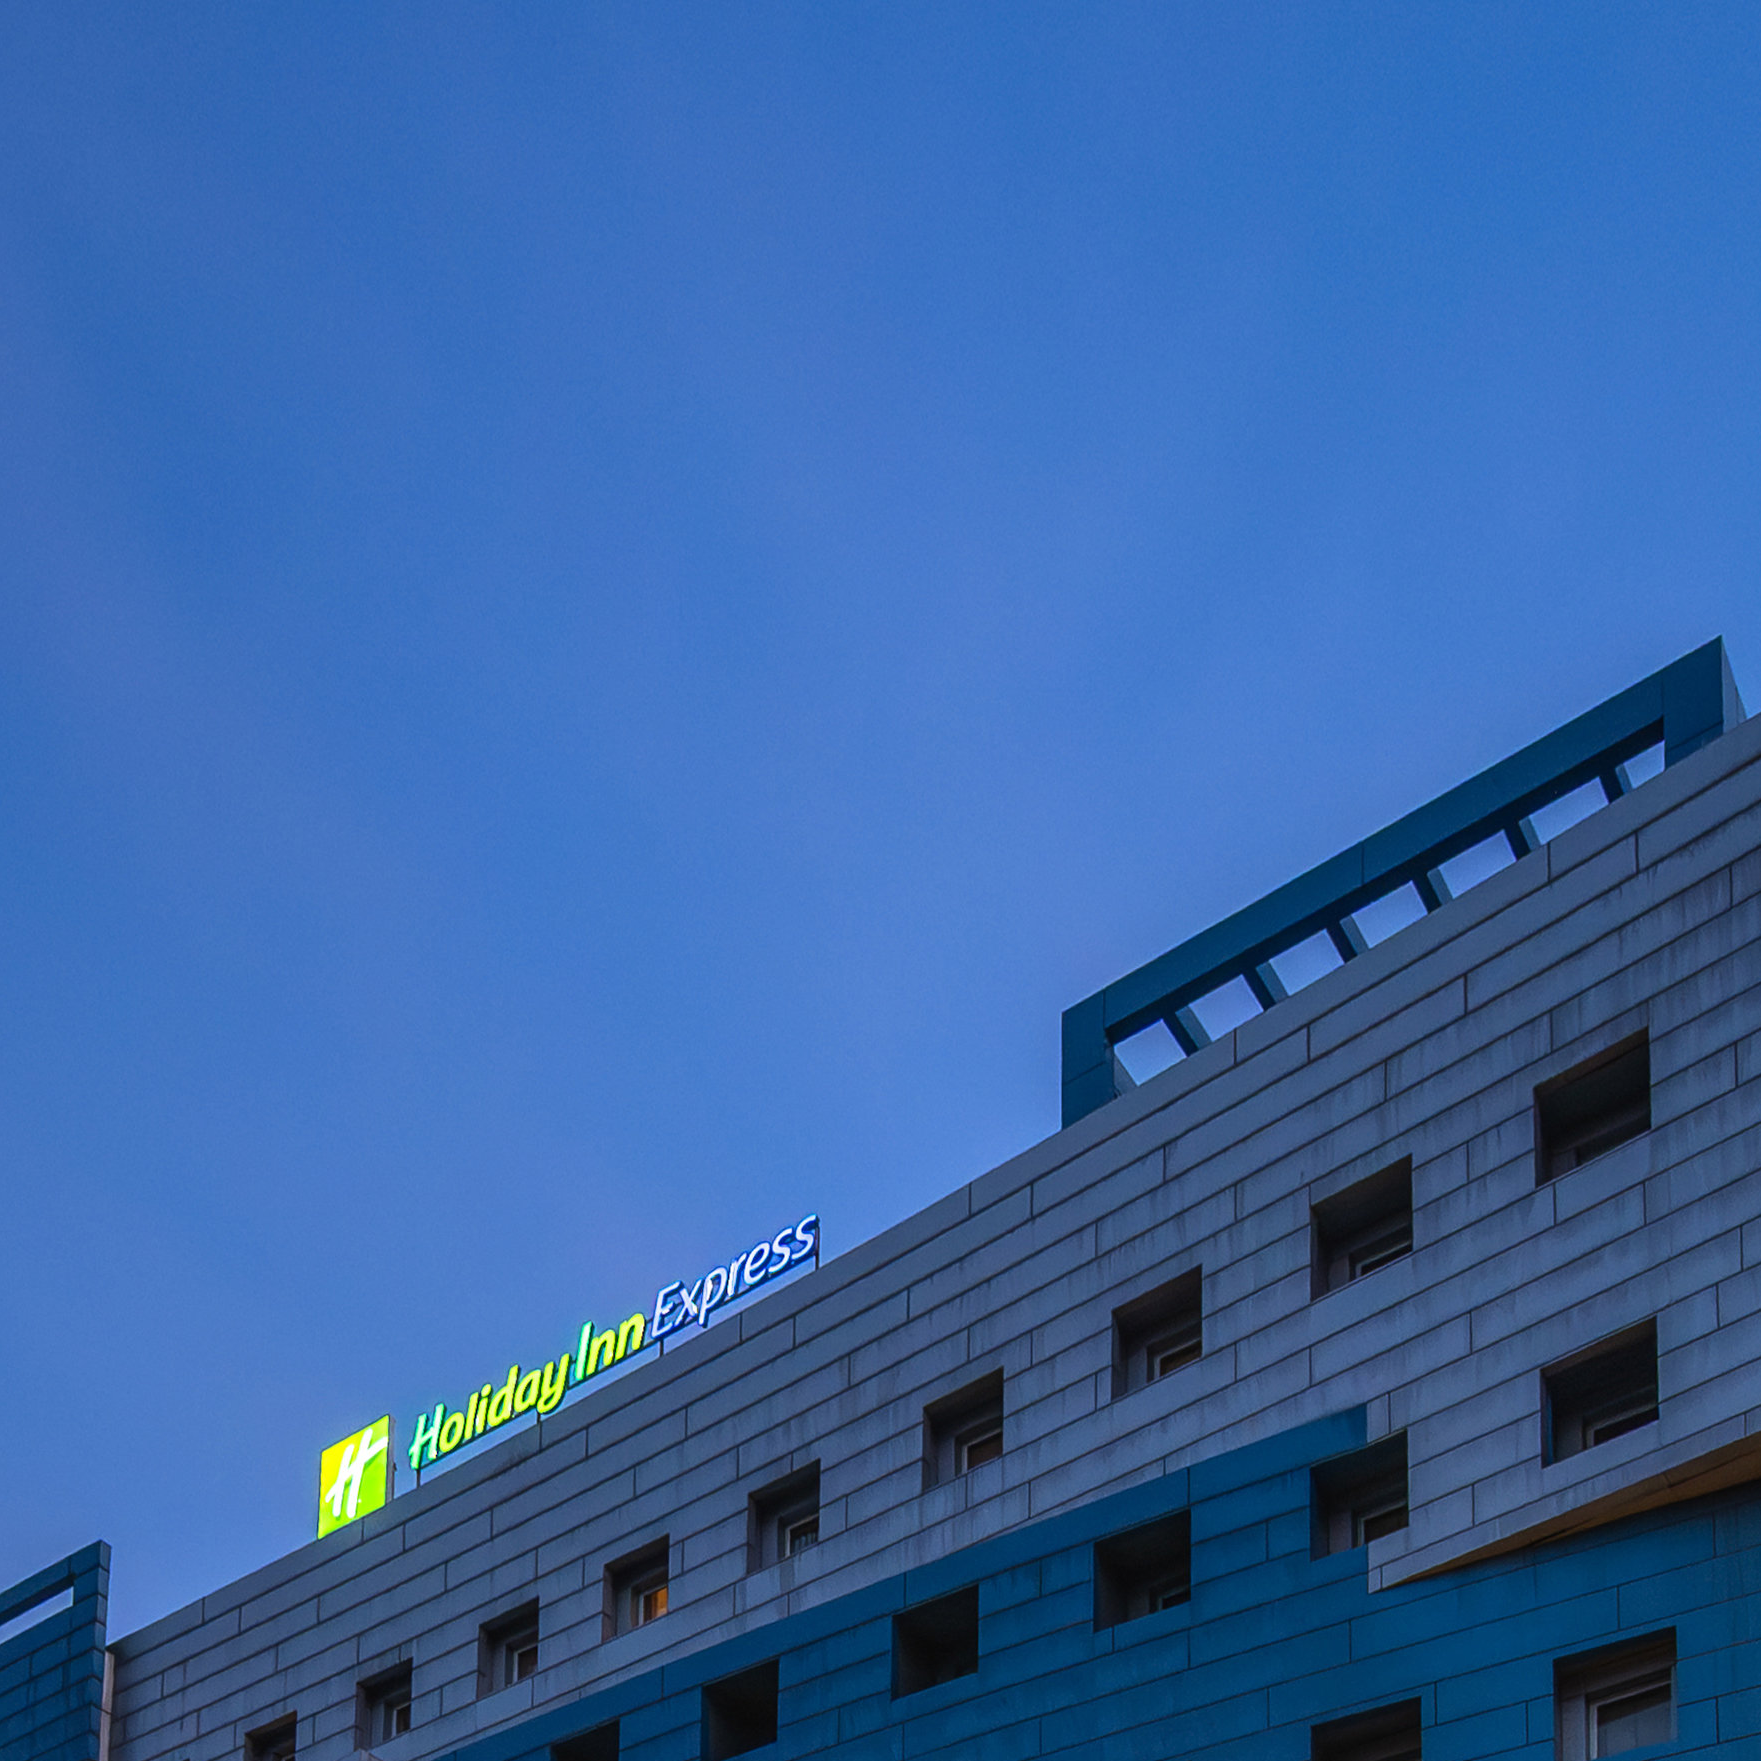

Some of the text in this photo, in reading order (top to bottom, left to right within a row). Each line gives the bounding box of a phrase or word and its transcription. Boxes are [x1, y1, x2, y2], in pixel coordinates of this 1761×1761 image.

[408, 1213, 820, 1470] Holiday Inn Express
